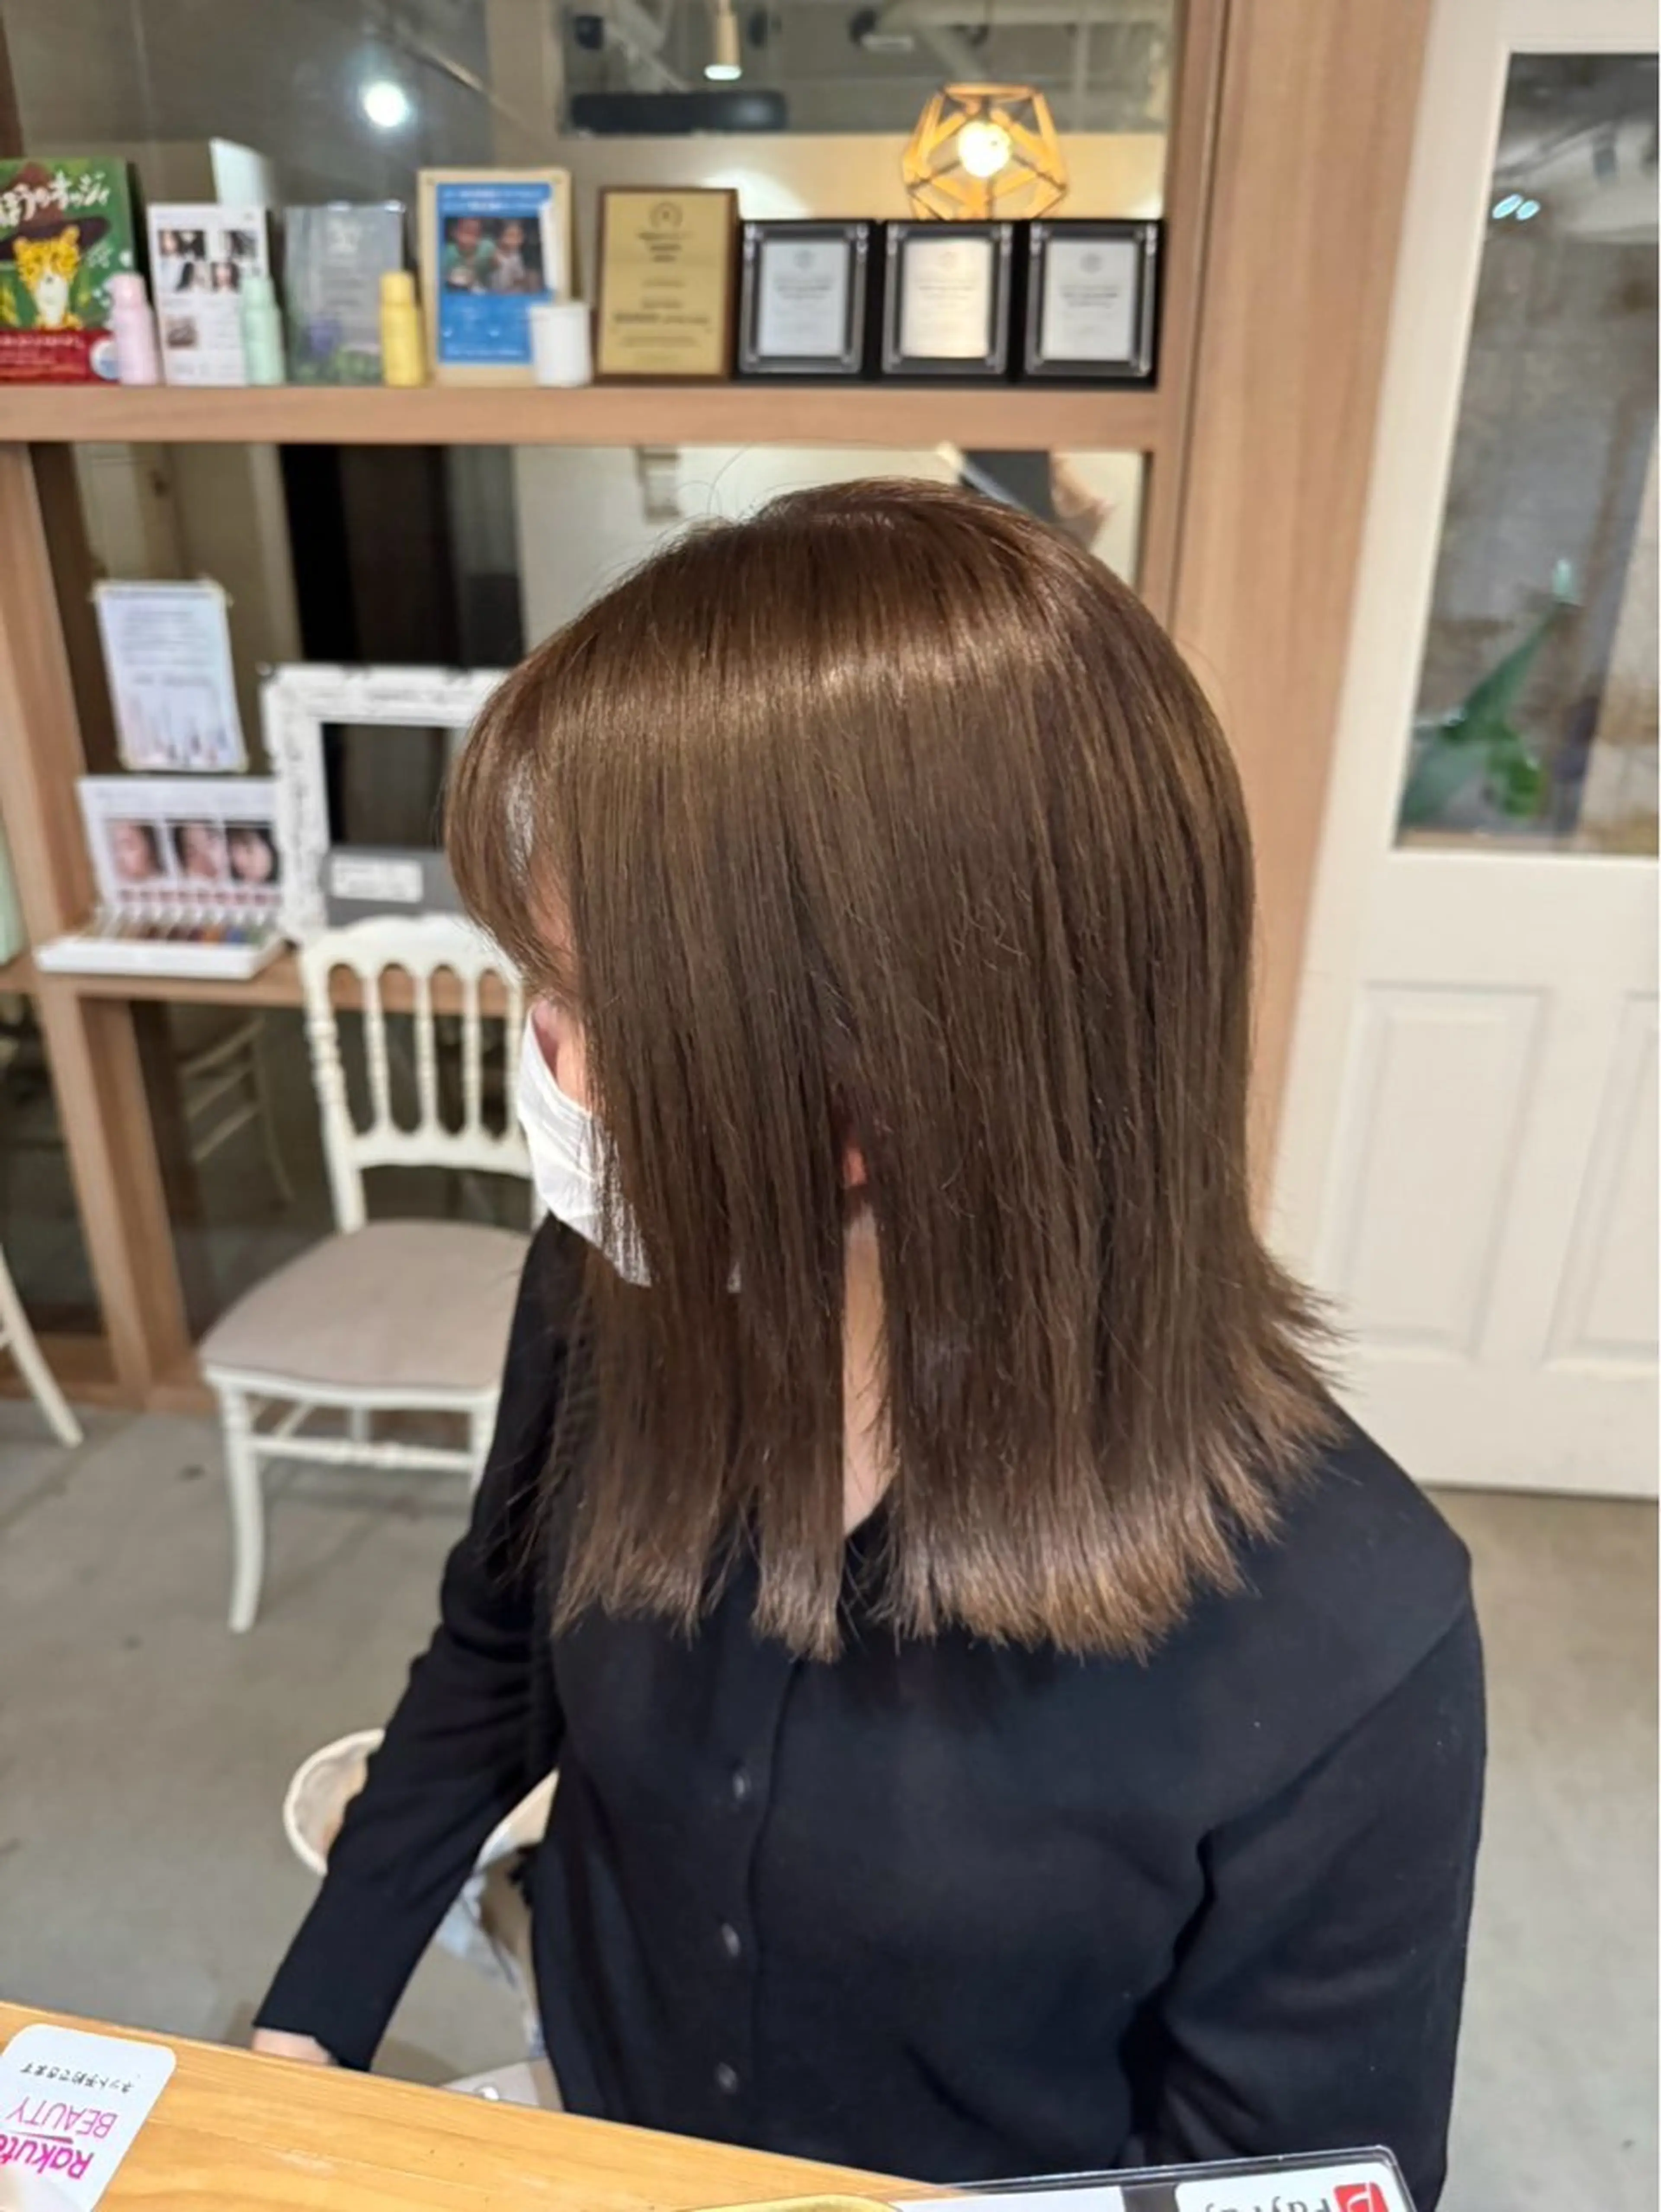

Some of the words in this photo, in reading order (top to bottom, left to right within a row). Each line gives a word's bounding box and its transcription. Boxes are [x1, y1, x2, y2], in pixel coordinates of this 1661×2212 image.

[20, 2062, 135, 2093] ネット予約できます
[6, 2096, 118, 2138] BEAUTY
